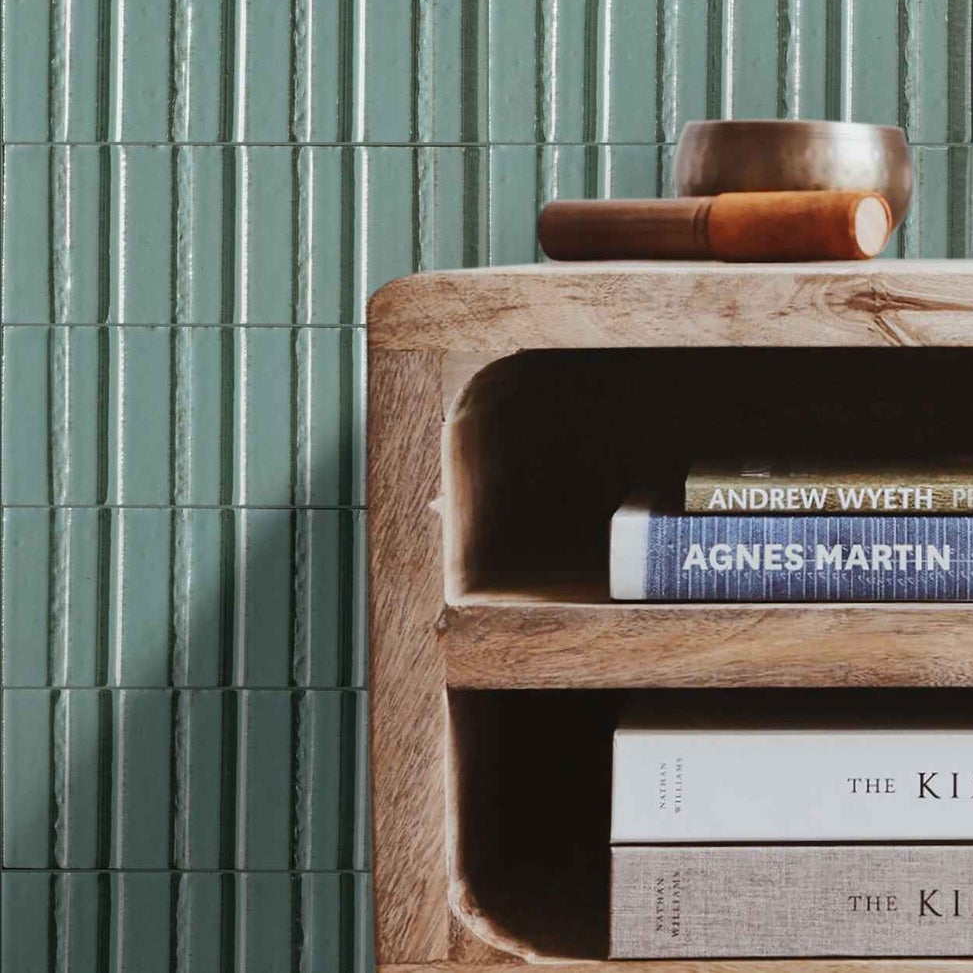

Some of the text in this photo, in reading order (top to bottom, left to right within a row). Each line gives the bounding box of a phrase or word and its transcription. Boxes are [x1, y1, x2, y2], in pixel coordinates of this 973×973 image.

[708, 488, 828, 509] ANDREW
[838, 488, 933, 509] WYETH
[682, 544, 950, 571] AGNES MARTIN
[659, 763, 667, 809] NATHAN
[847, 777, 896, 794] THE
[656, 878, 664, 931] NATHAN
[672, 871, 681, 938] WILLIAMS
[848, 895, 898, 912] THE
